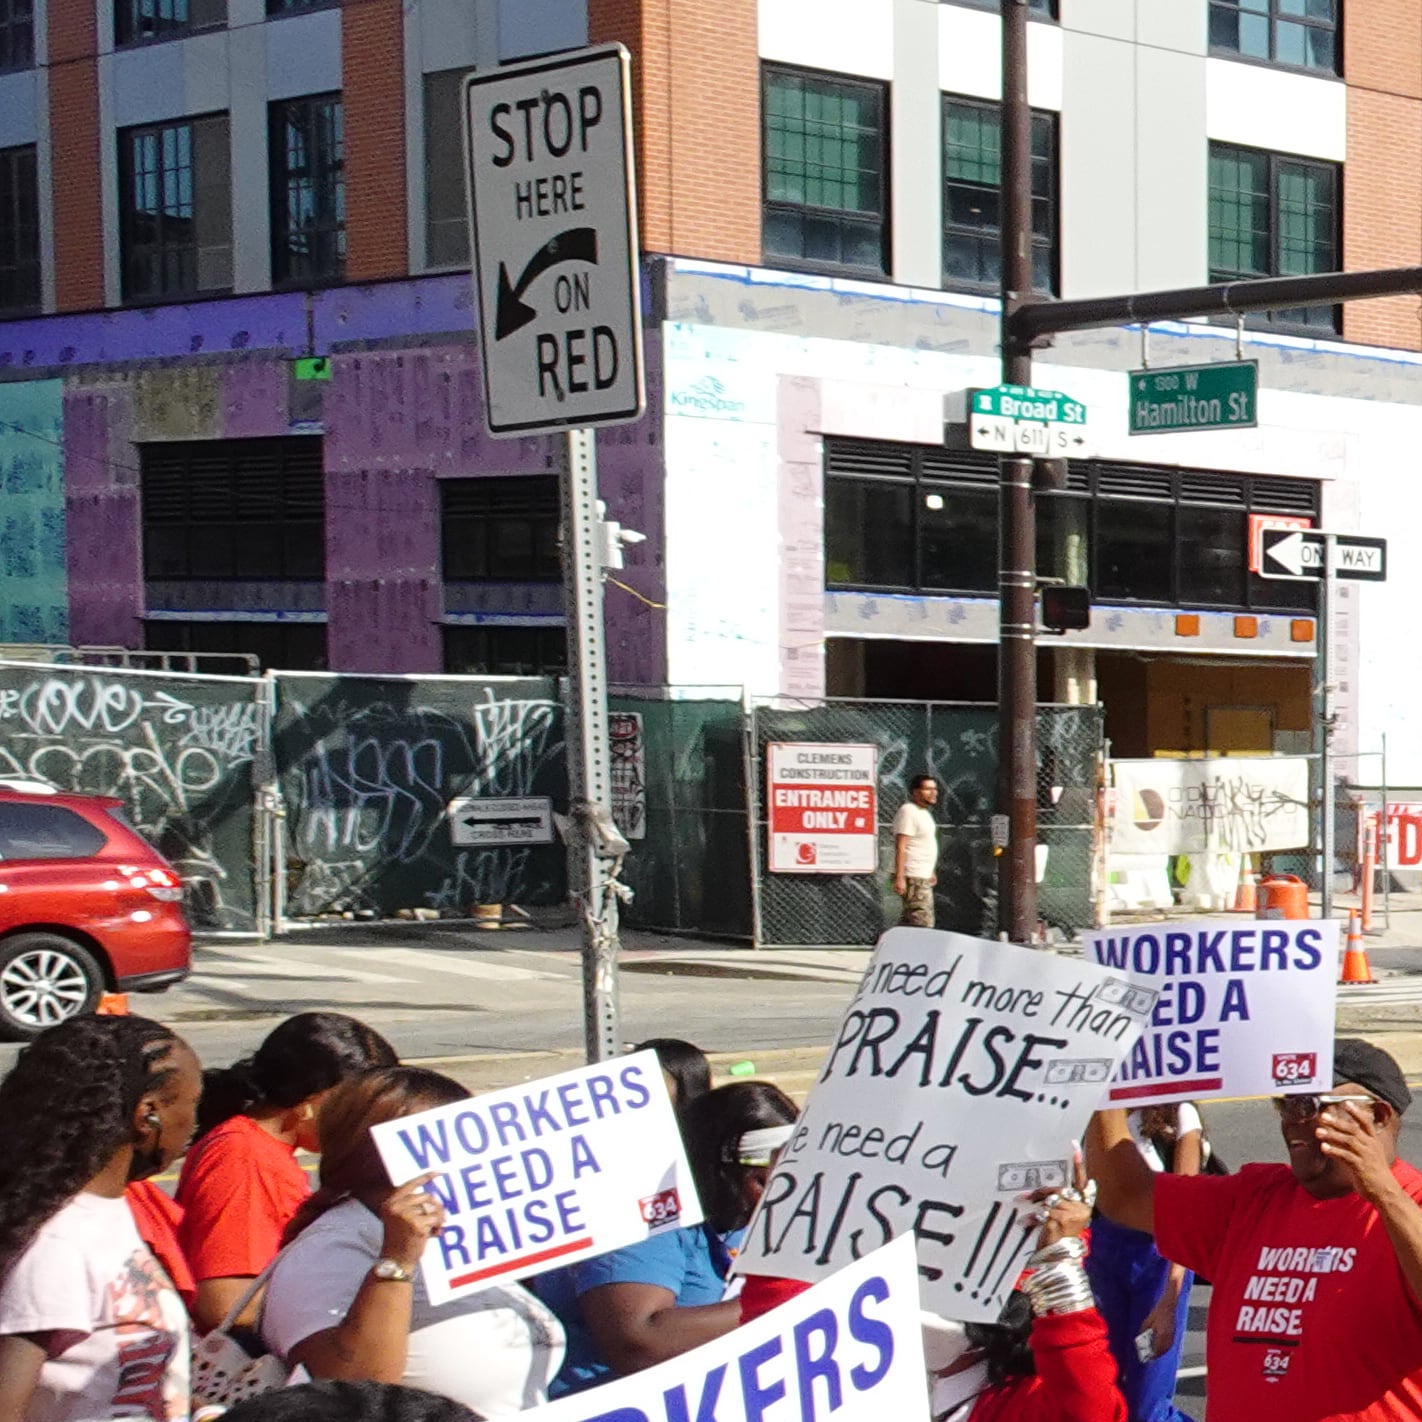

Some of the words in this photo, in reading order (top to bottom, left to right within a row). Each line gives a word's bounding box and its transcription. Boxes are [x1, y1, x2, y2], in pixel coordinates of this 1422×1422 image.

[490, 84, 602, 168] STOP
[515, 171, 586, 220] HERE
[554, 272, 590, 314] ON
[536, 324, 619, 402] RED
[1001, 396, 1056, 420] Broad
[1063, 401, 1084, 423] St
[1136, 393, 1221, 428] Hamilton
[1228, 391, 1248, 421] St
[993, 424, 1006, 442] N
[1020, 427, 1044, 446] 611
[1057, 430, 1068, 447] S
[1300, 545, 1324, 565] ON
[1342, 549, 1376, 567] WAY
[780, 768, 869, 780] CONSTRUCTION
[797, 752, 853, 765] CLEMENS
[775, 789, 870, 808] ENTRANCE
[802, 811, 848, 829] ONLY
[1094, 928, 1322, 977] WORKERS
[869, 954, 963, 999] need
[959, 977, 1043, 1019] more
[1049, 980, 1132, 1041] than
[1151, 980, 1206, 1028] ED
[1220, 978, 1250, 1023] A
[820, 1006, 1071, 1110] PRAISE...
[1113, 1028, 1221, 1081] AISE
[1276, 1060, 1311, 1080] 634
[397, 1065, 651, 1171] WORKERS
[819, 1120, 924, 1166] need
[921, 1143, 959, 1179] a
[421, 1146, 555, 1217] NEED
[571, 1133, 602, 1180] A
[643, 1191, 679, 1221] 634
[437, 1189, 586, 1271] RAISE
[1243, 1275, 1305, 1304] NEED
[1302, 1277, 1318, 1303] A
[1263, 1355, 1290, 1371] 634
